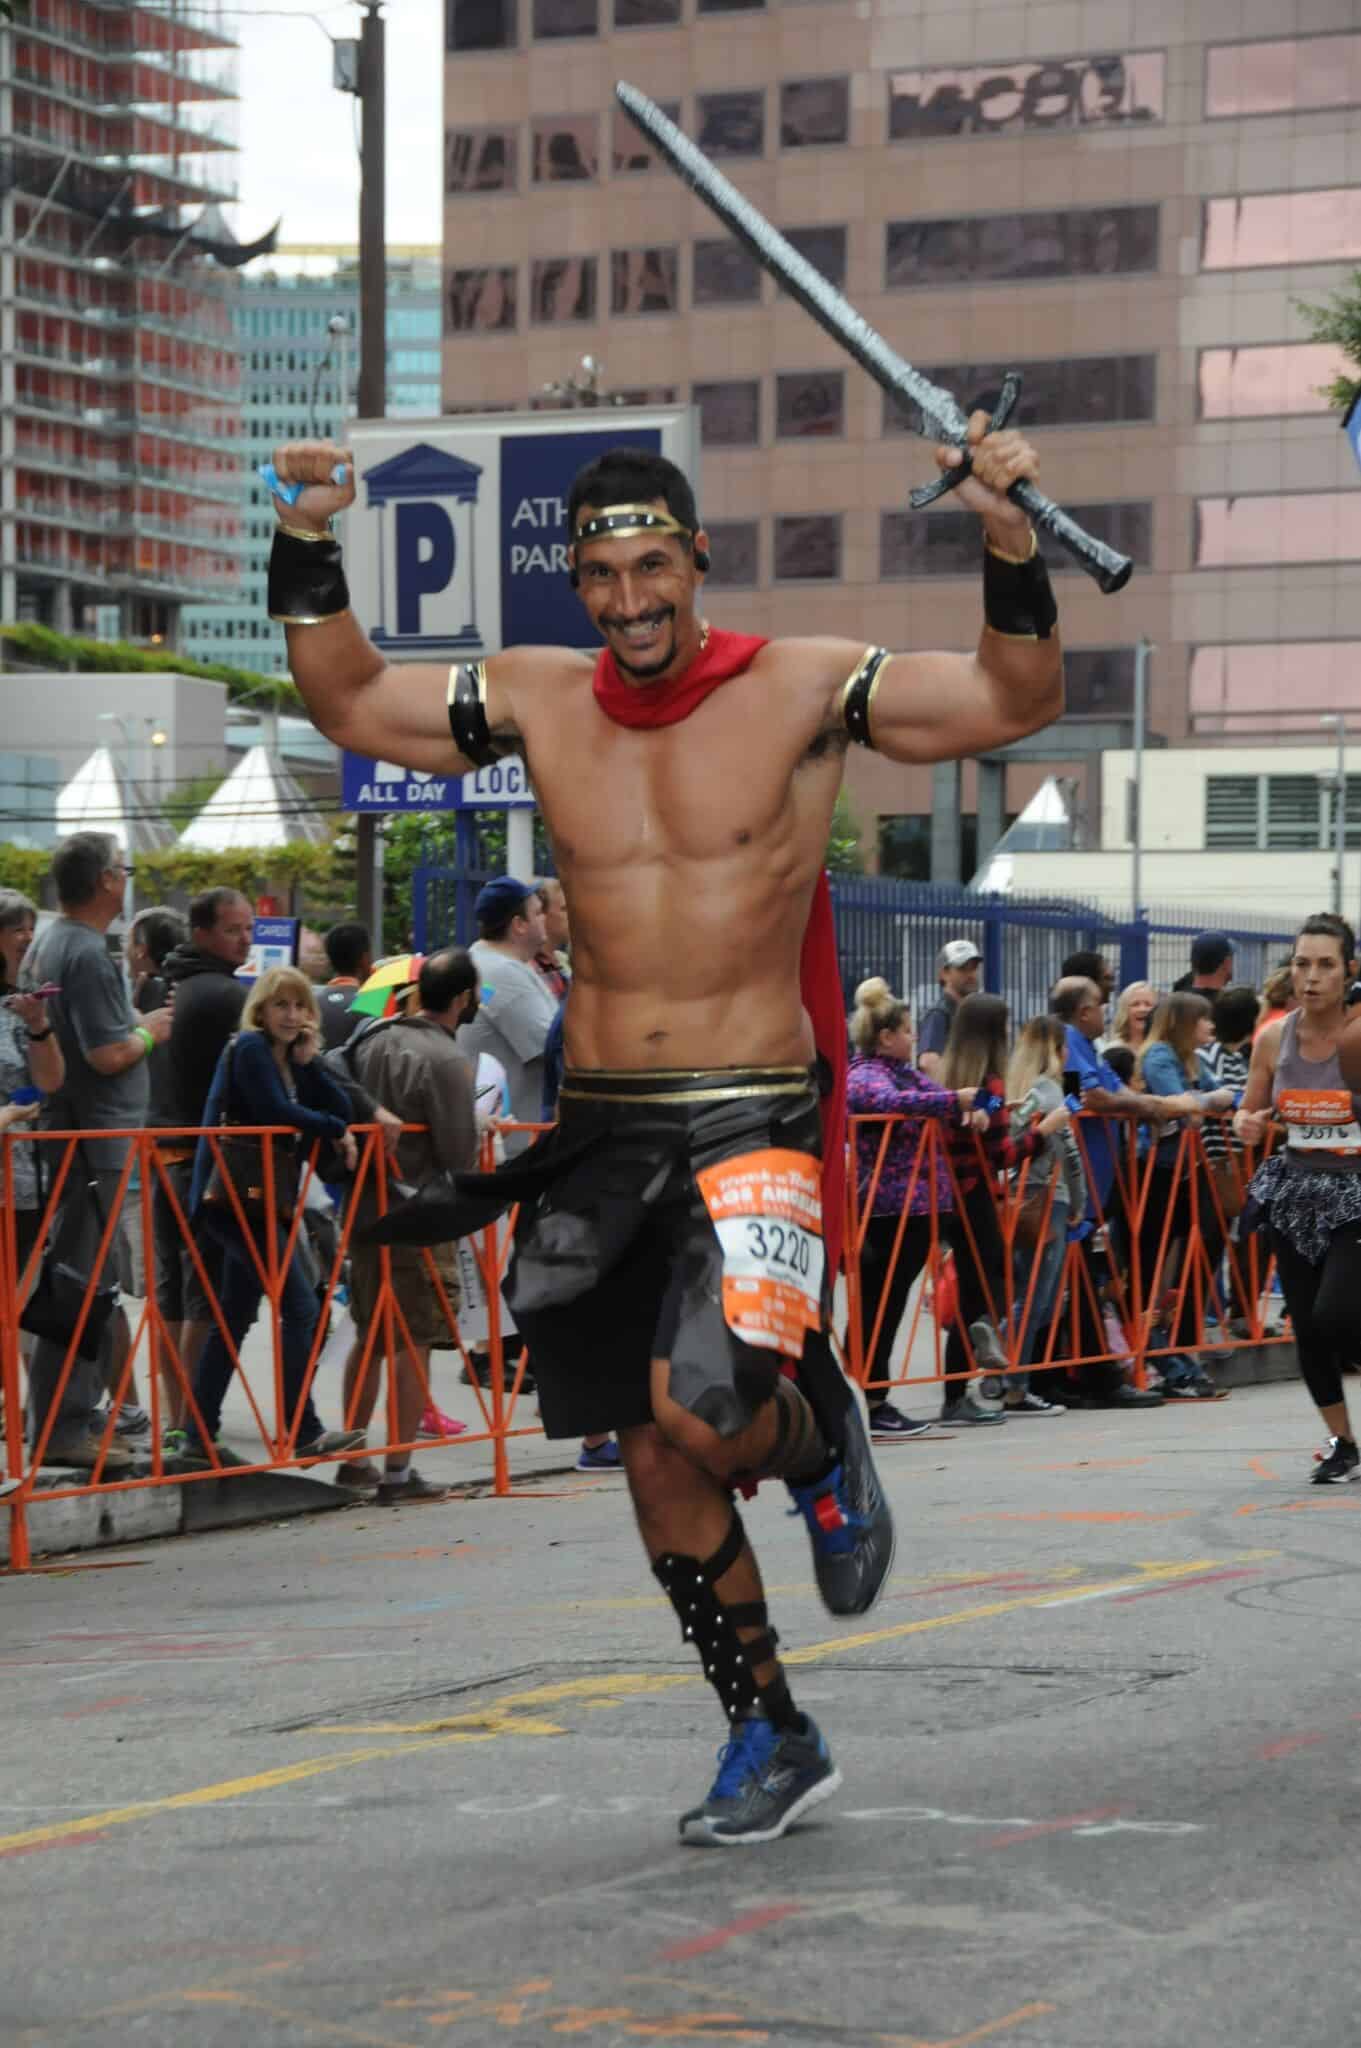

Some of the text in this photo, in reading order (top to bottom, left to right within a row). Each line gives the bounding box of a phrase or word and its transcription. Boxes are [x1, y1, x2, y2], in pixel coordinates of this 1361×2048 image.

[394, 501, 456, 634] P
[511, 544, 569, 575] PAR
[358, 783, 448, 803] ALL DAY
[474, 766, 530, 794] LOC
[747, 1222, 811, 1276] 3220
